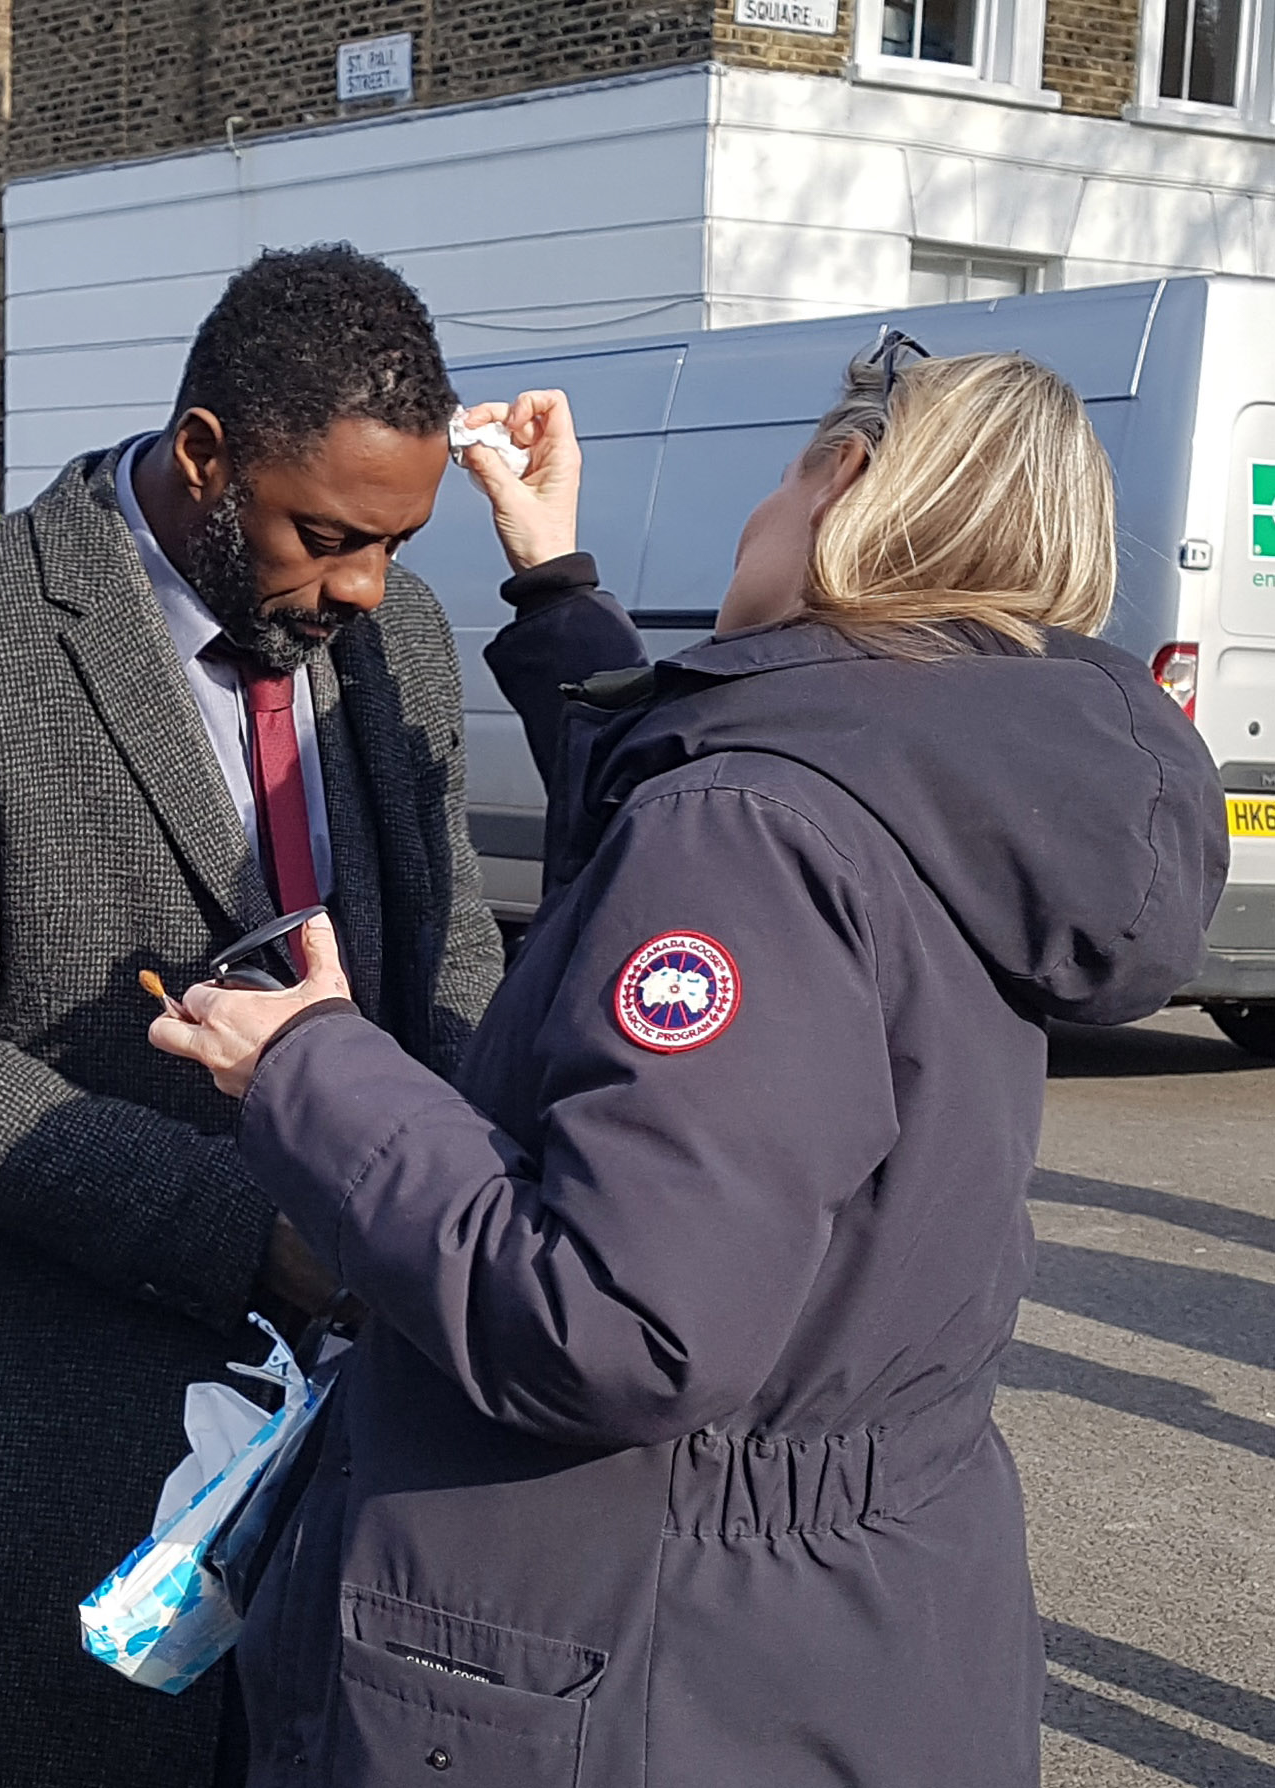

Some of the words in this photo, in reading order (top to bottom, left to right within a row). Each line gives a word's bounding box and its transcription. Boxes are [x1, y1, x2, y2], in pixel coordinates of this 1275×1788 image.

[745, 0, 812, 26] SQUARE
[348, 70, 390, 93] STREET
[639, 940, 687, 964] CANADA
[625, 1010, 656, 1037] ARCTIC
[656, 1021, 713, 1041] PROGRAM
